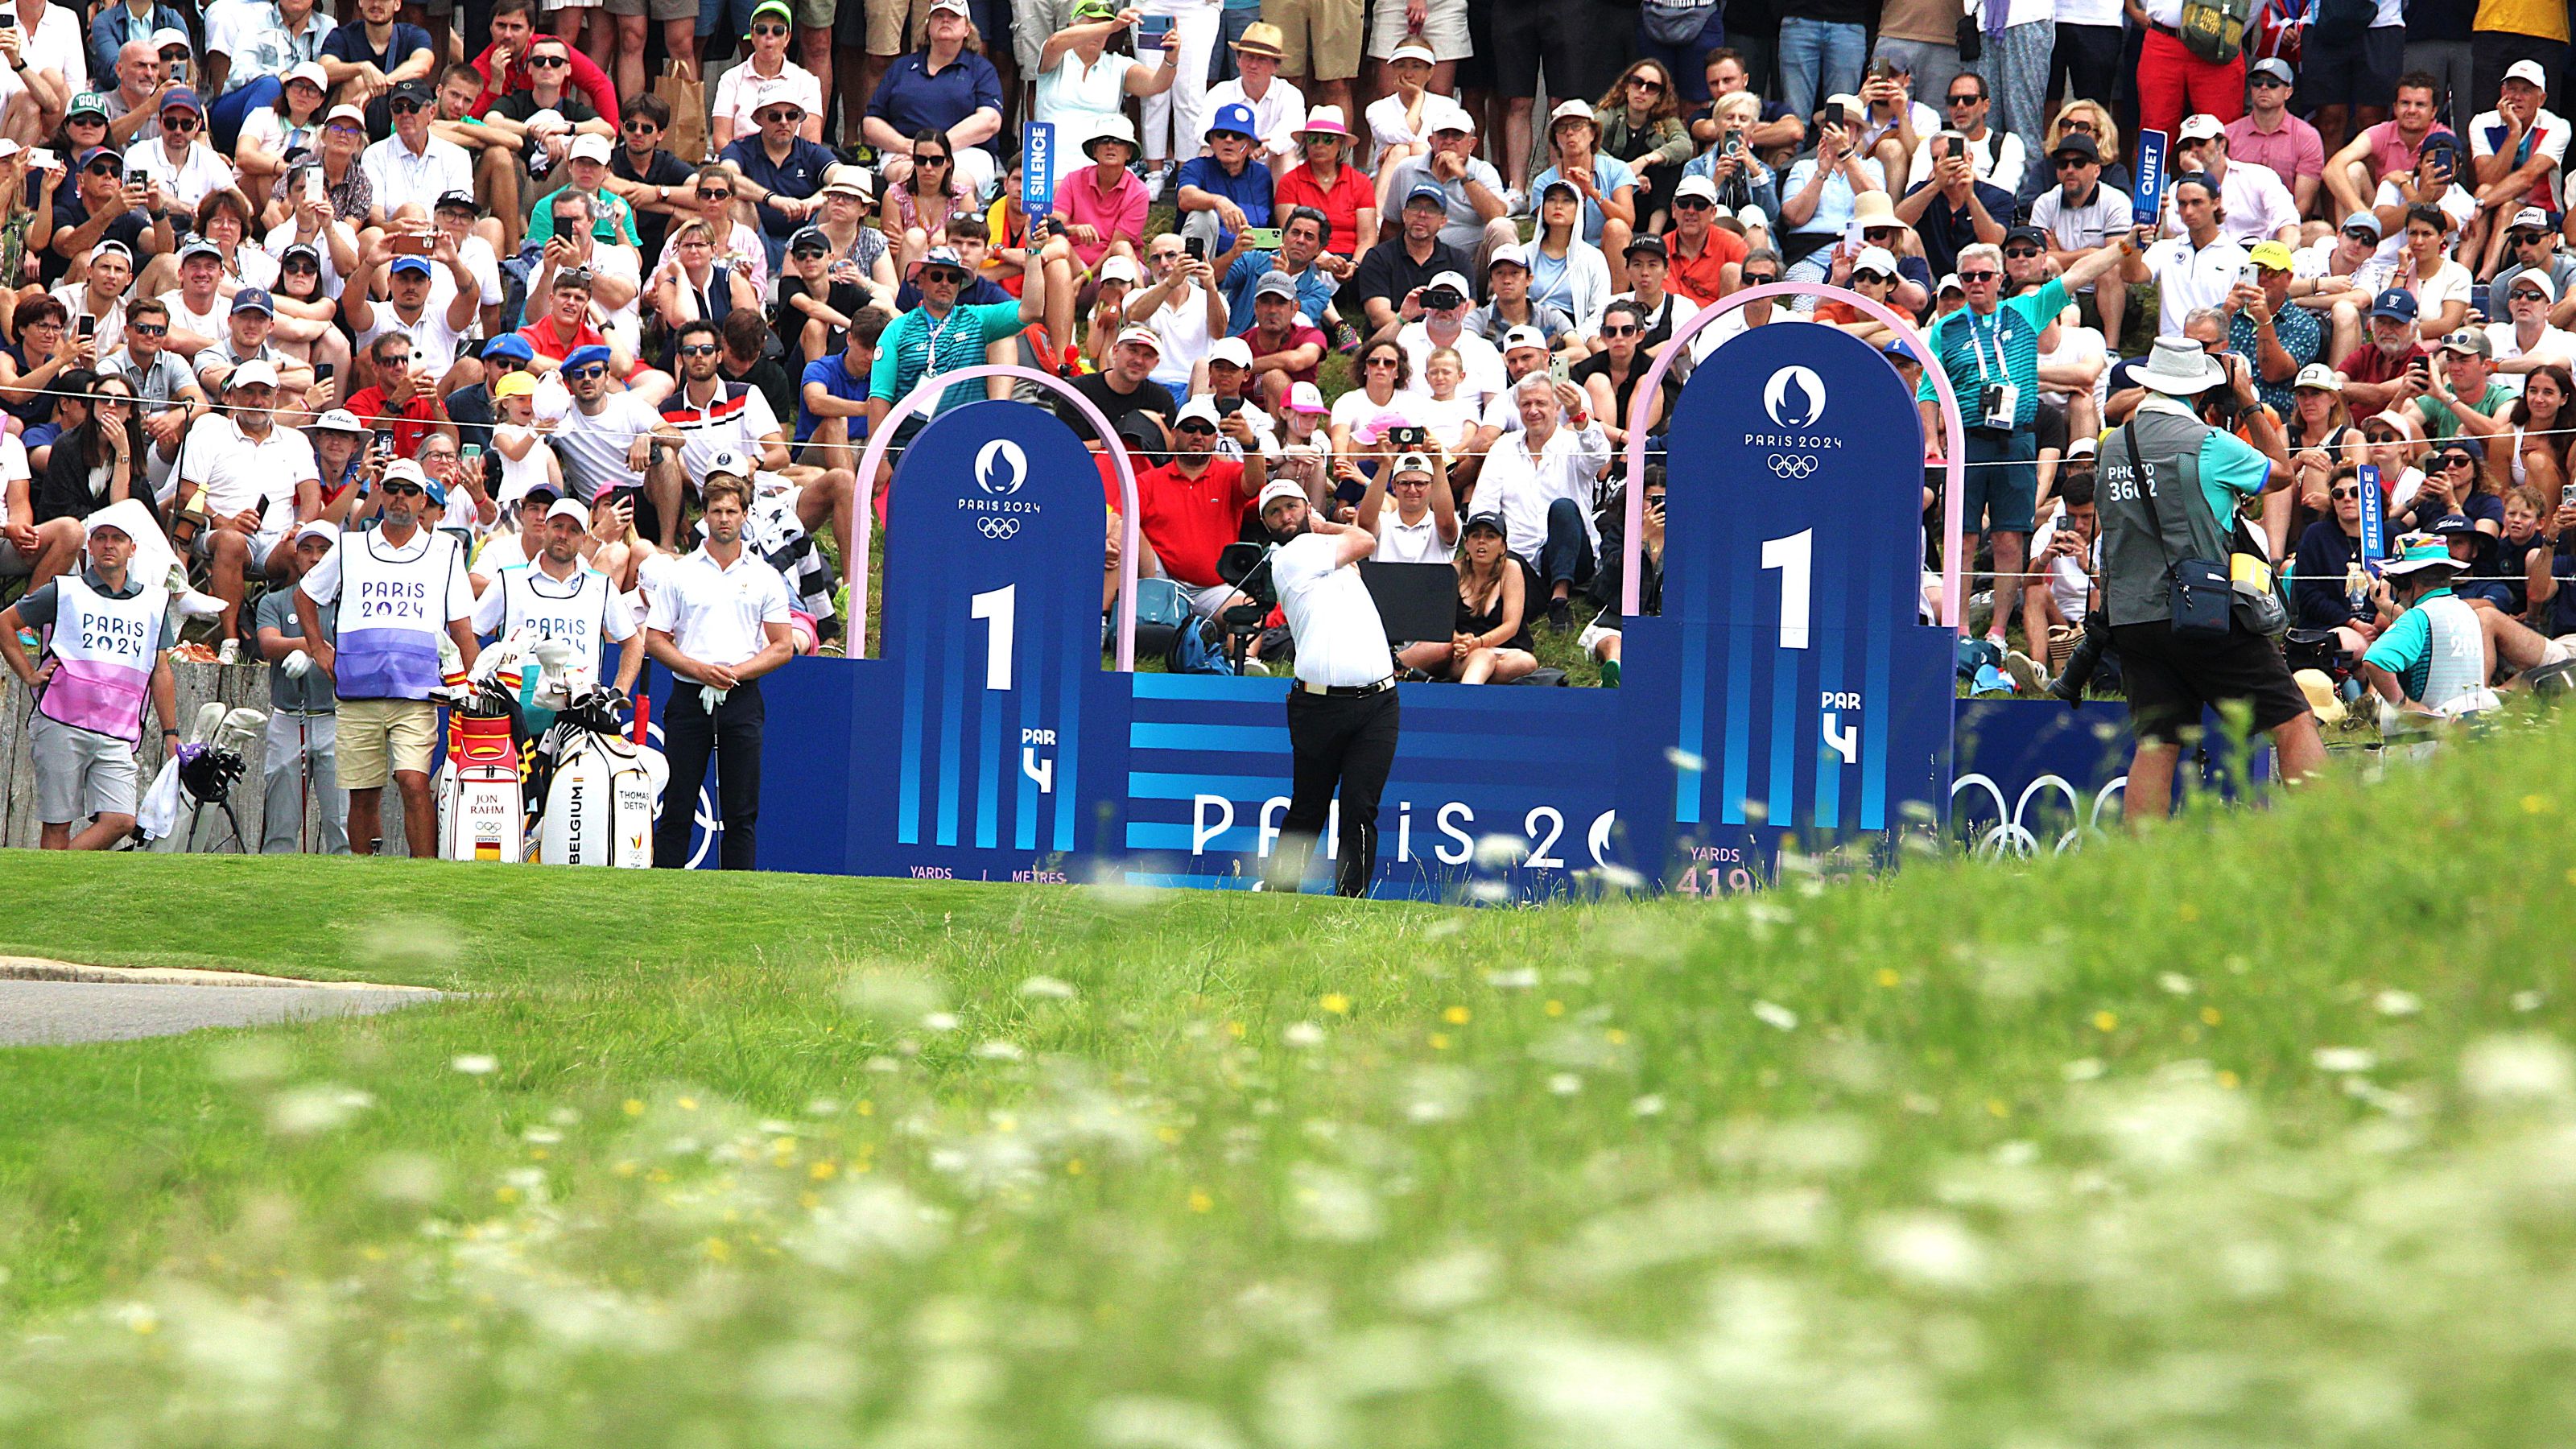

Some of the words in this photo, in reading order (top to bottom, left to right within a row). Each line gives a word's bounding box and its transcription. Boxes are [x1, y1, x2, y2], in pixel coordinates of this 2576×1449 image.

[78, 94, 102, 109] GOLF
[1030, 126, 1046, 196] SILENCE
[2141, 145, 2157, 196] QUIET
[1744, 434, 1793, 448] PARIS
[1798, 436, 1843, 449] 2024
[957, 498, 999, 512] PARIS
[1003, 500, 1041, 514] 2024
[2363, 471, 2378, 550] SILENCE
[362, 581, 424, 599] PARIS
[1761, 527, 1812, 649] 1
[83, 613, 143, 637] PARIS
[971, 583, 1015, 691] 1
[1821, 691, 1860, 711] PAR
[1022, 728, 1056, 745] PAR
[1823, 712, 1857, 764] 4
[1022, 747, 1052, 793] 4
[476, 795, 497, 805] JON
[620, 791, 650, 800] THOMAS
[470, 805, 504, 815] RAHM
[624, 802, 646, 811] DETRY
[569, 786, 583, 865] BELGIUM
[1690, 848, 1740, 863] YARDS
[910, 865, 952, 880] YARDS
